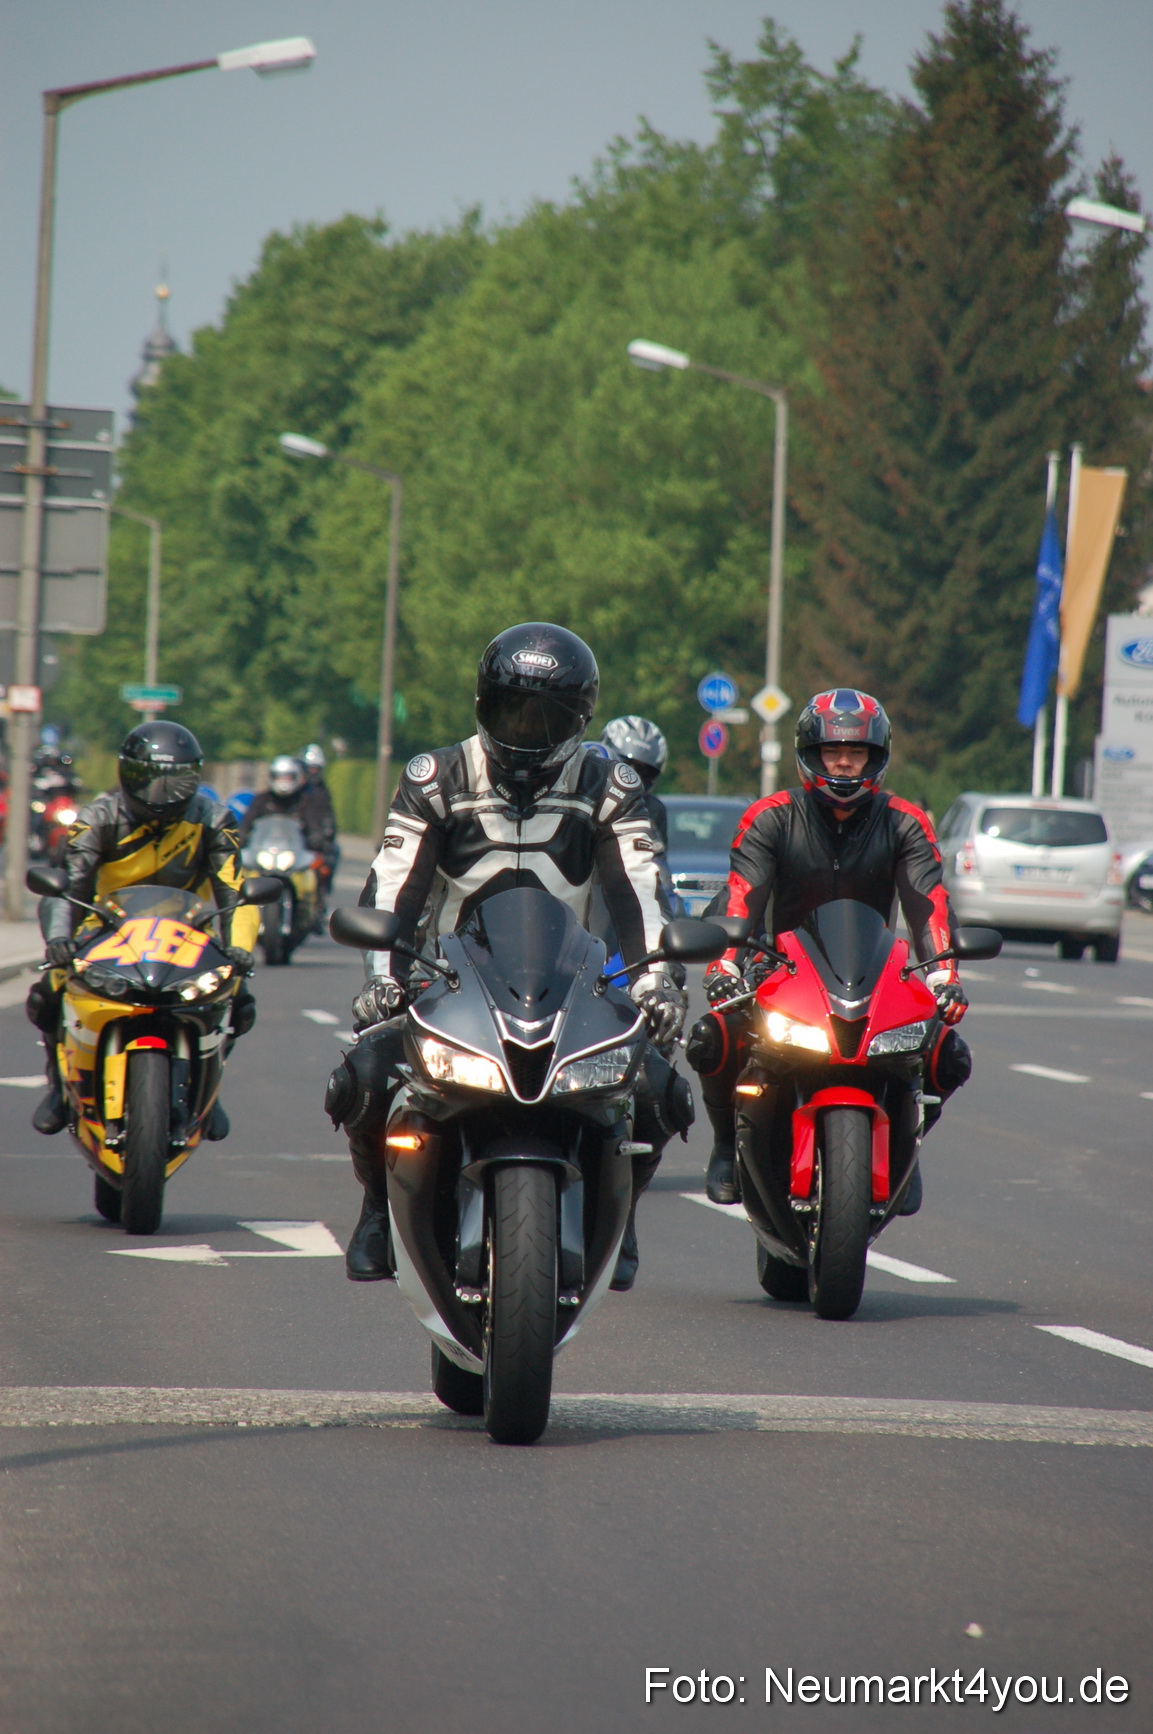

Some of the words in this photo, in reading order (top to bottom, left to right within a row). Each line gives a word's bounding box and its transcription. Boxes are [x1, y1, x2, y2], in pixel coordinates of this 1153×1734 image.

[517, 652, 553, 668] SHOEI
[832, 727, 861, 736] uvex
[83, 916, 212, 969] 46
